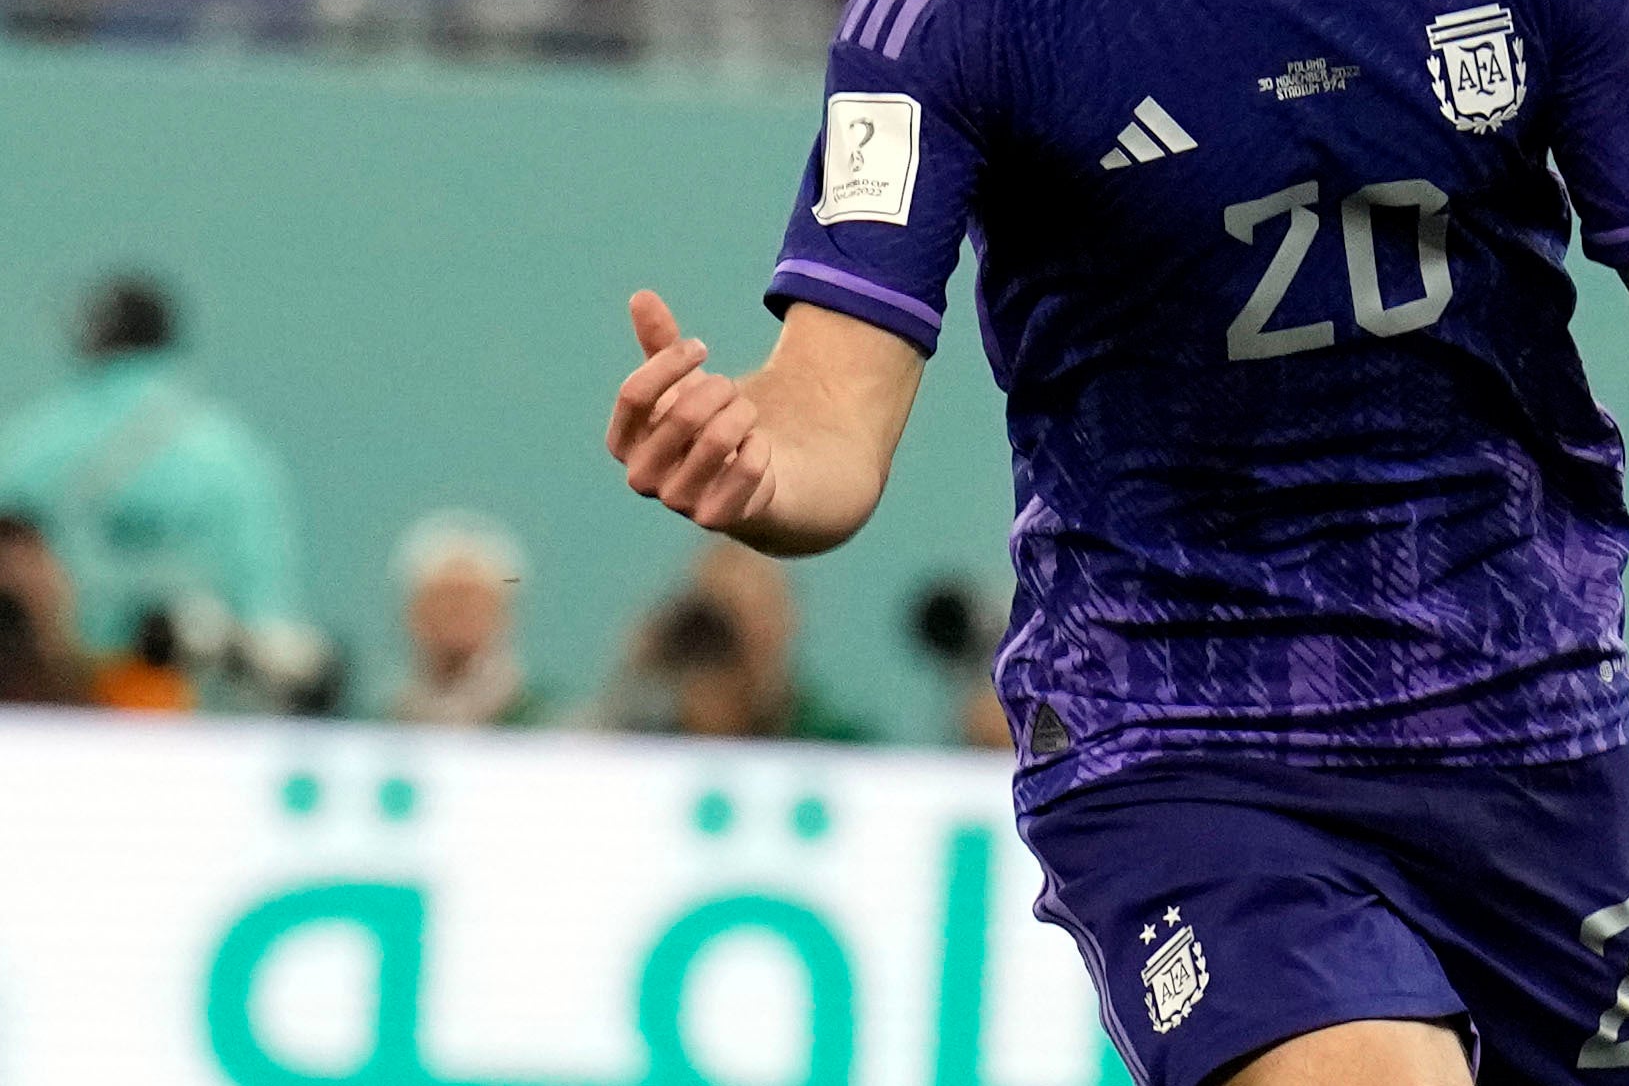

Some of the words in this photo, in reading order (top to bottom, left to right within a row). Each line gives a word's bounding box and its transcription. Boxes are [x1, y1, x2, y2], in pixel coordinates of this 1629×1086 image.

[1257, 77, 1273, 92] 30
[1276, 68, 1328, 89] NOVEMBER
[1287, 57, 1326, 75] POLAND
[1458, 40, 1507, 95] AFA
[1276, 81, 1320, 101] STADIUM
[1323, 74, 1346, 93] 974
[1223, 178, 1453, 362] 20
[1161, 956, 1190, 1006] AFA
